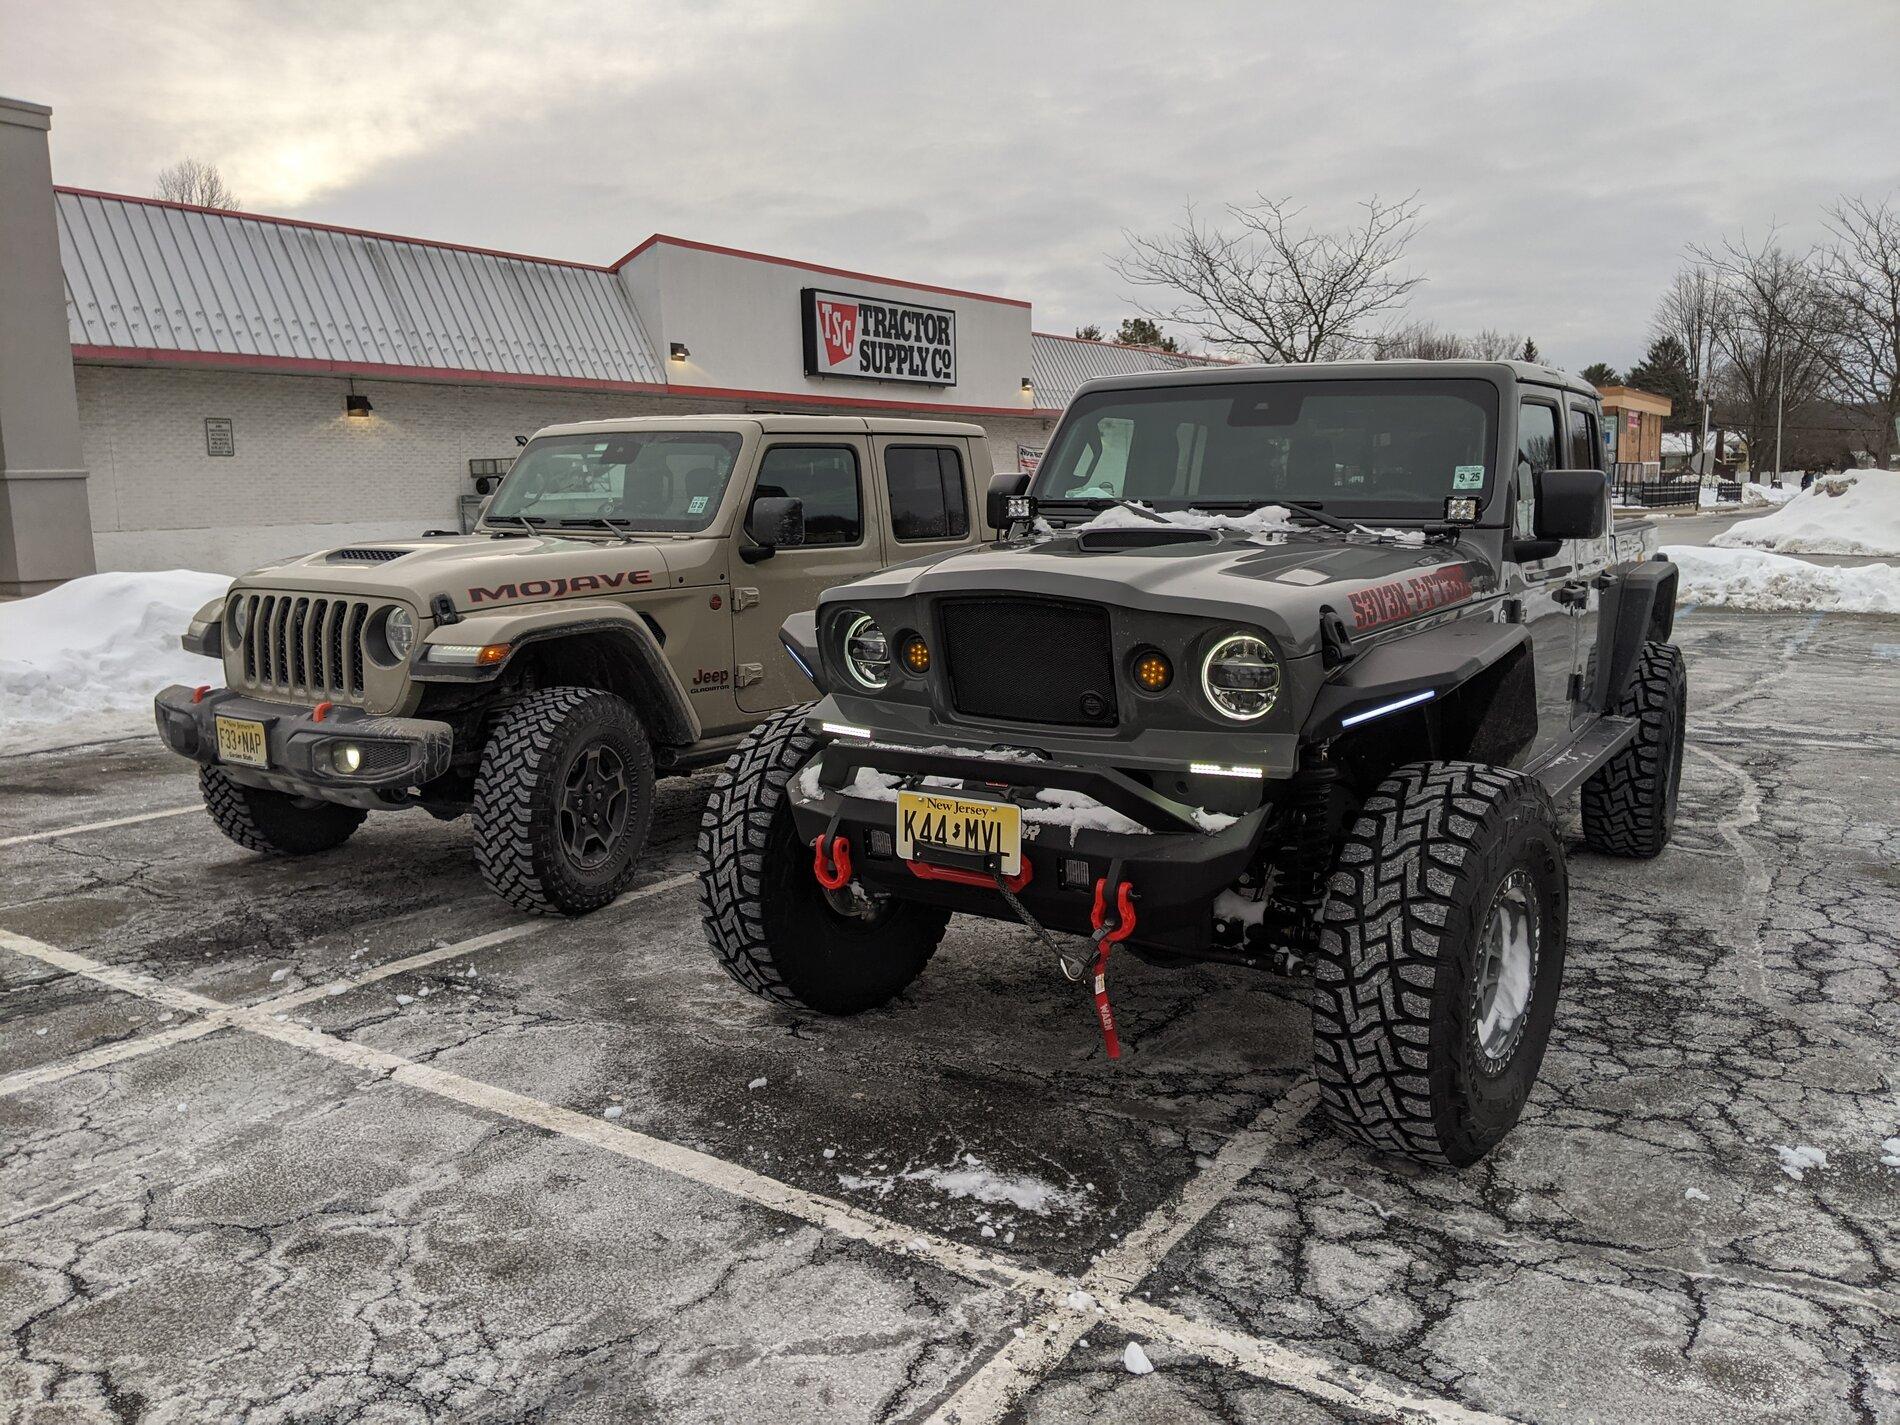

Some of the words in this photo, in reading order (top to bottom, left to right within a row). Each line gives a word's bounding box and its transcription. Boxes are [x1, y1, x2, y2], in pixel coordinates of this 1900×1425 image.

[821, 303, 852, 355] TSC
[858, 303, 951, 347] TRACTOR
[859, 339, 929, 377] SUPPLY
[1459, 473, 1465, 483] 9
[1470, 472, 1480, 482] 25
[468, 570, 652, 602] MOJAVE
[690, 685, 730, 694] GLADIATOR
[692, 669, 729, 685] Jeep
[241, 731, 261, 754] NAP
[926, 797, 953, 811] New
[953, 801, 989, 818] Jersey
[904, 809, 947, 847] K44
[1099, 1003, 1114, 1031] WARN
